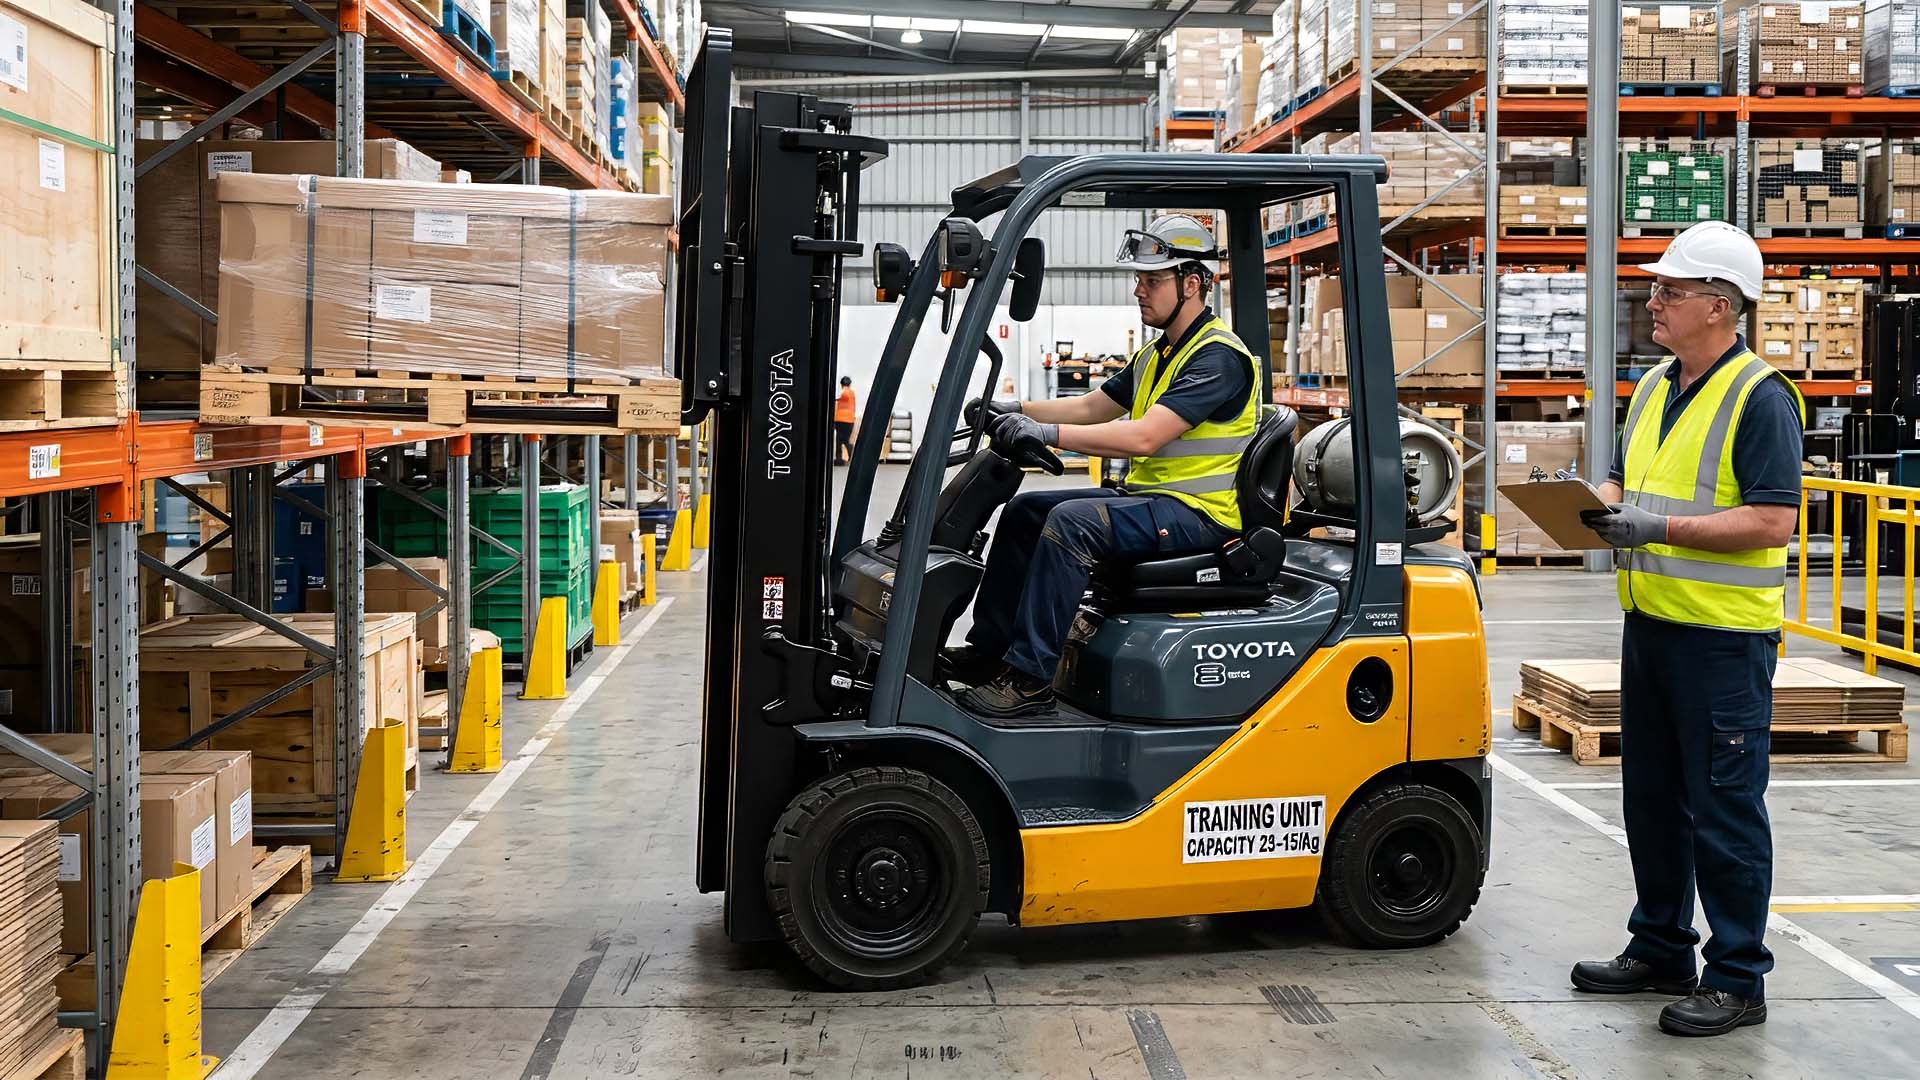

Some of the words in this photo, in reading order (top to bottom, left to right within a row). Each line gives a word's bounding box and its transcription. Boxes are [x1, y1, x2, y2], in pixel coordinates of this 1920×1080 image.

[768, 348, 794, 480] TOYOTA
[1191, 641, 1296, 660] TOYOTA
[1187, 802, 1275, 833] TRAINING
[1280, 800, 1323, 828] UNIT
[1187, 835, 1256, 857] CAPACITY
